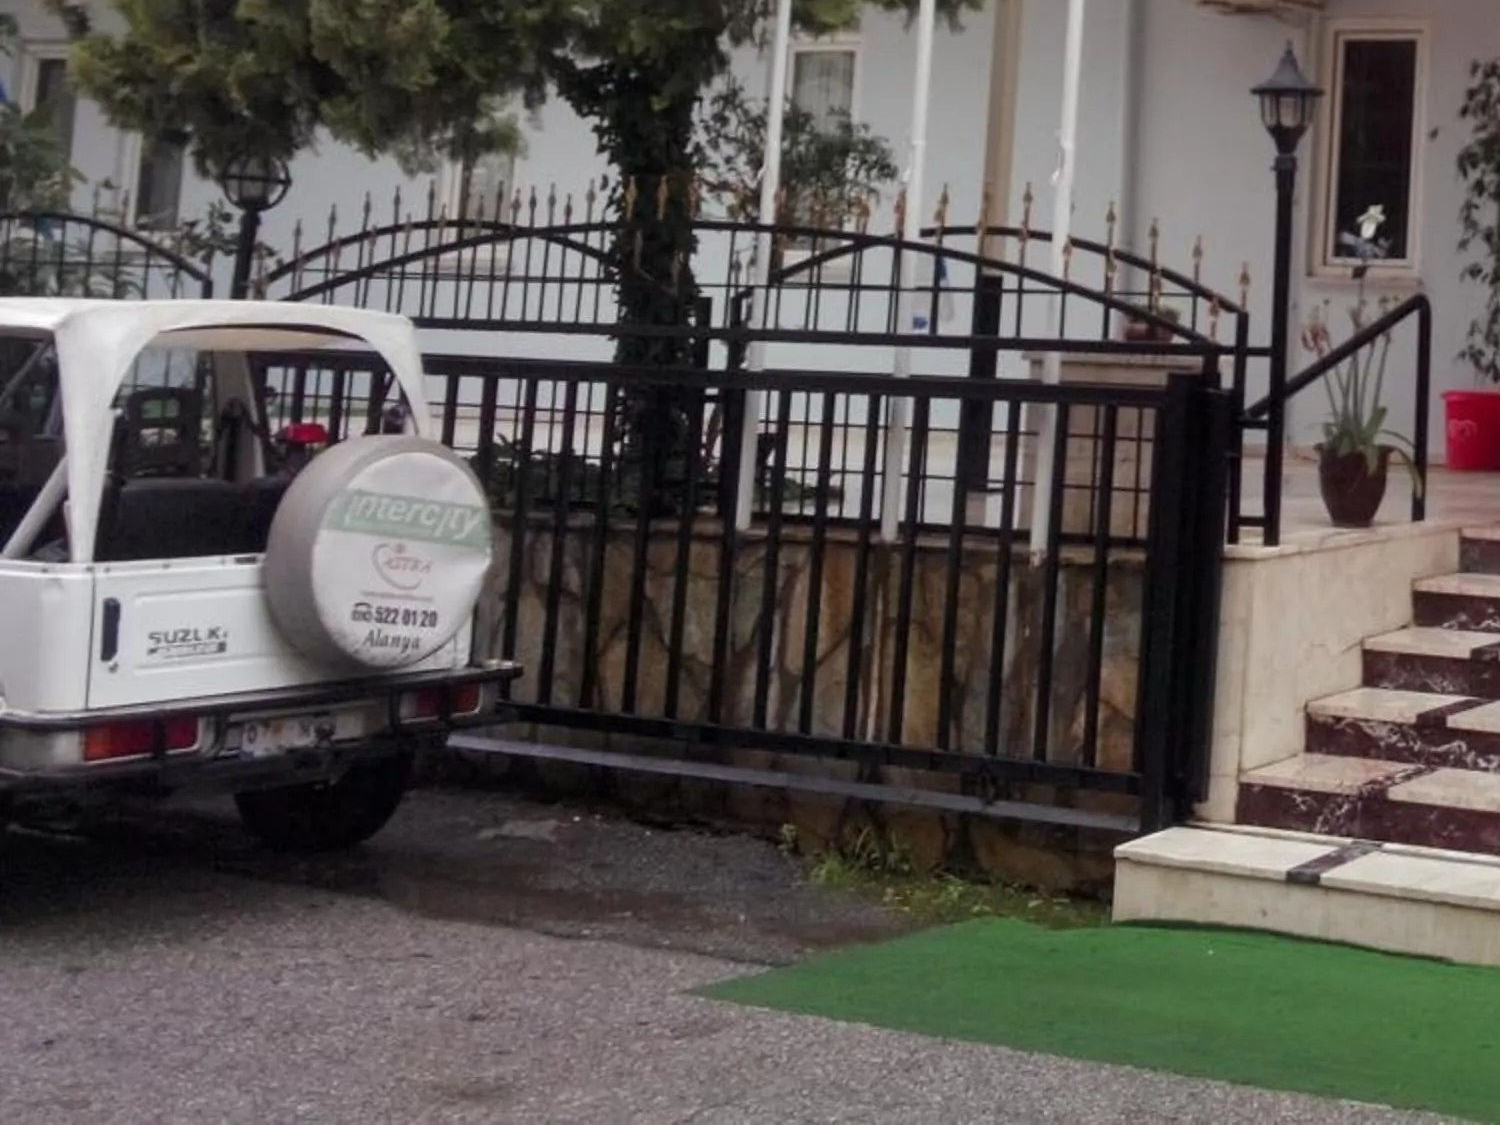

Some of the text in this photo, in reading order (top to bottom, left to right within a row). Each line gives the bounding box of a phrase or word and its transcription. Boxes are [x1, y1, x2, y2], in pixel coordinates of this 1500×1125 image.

[374, 605, 438, 629] 522 01 20
[361, 628, 420, 654] Alanya
